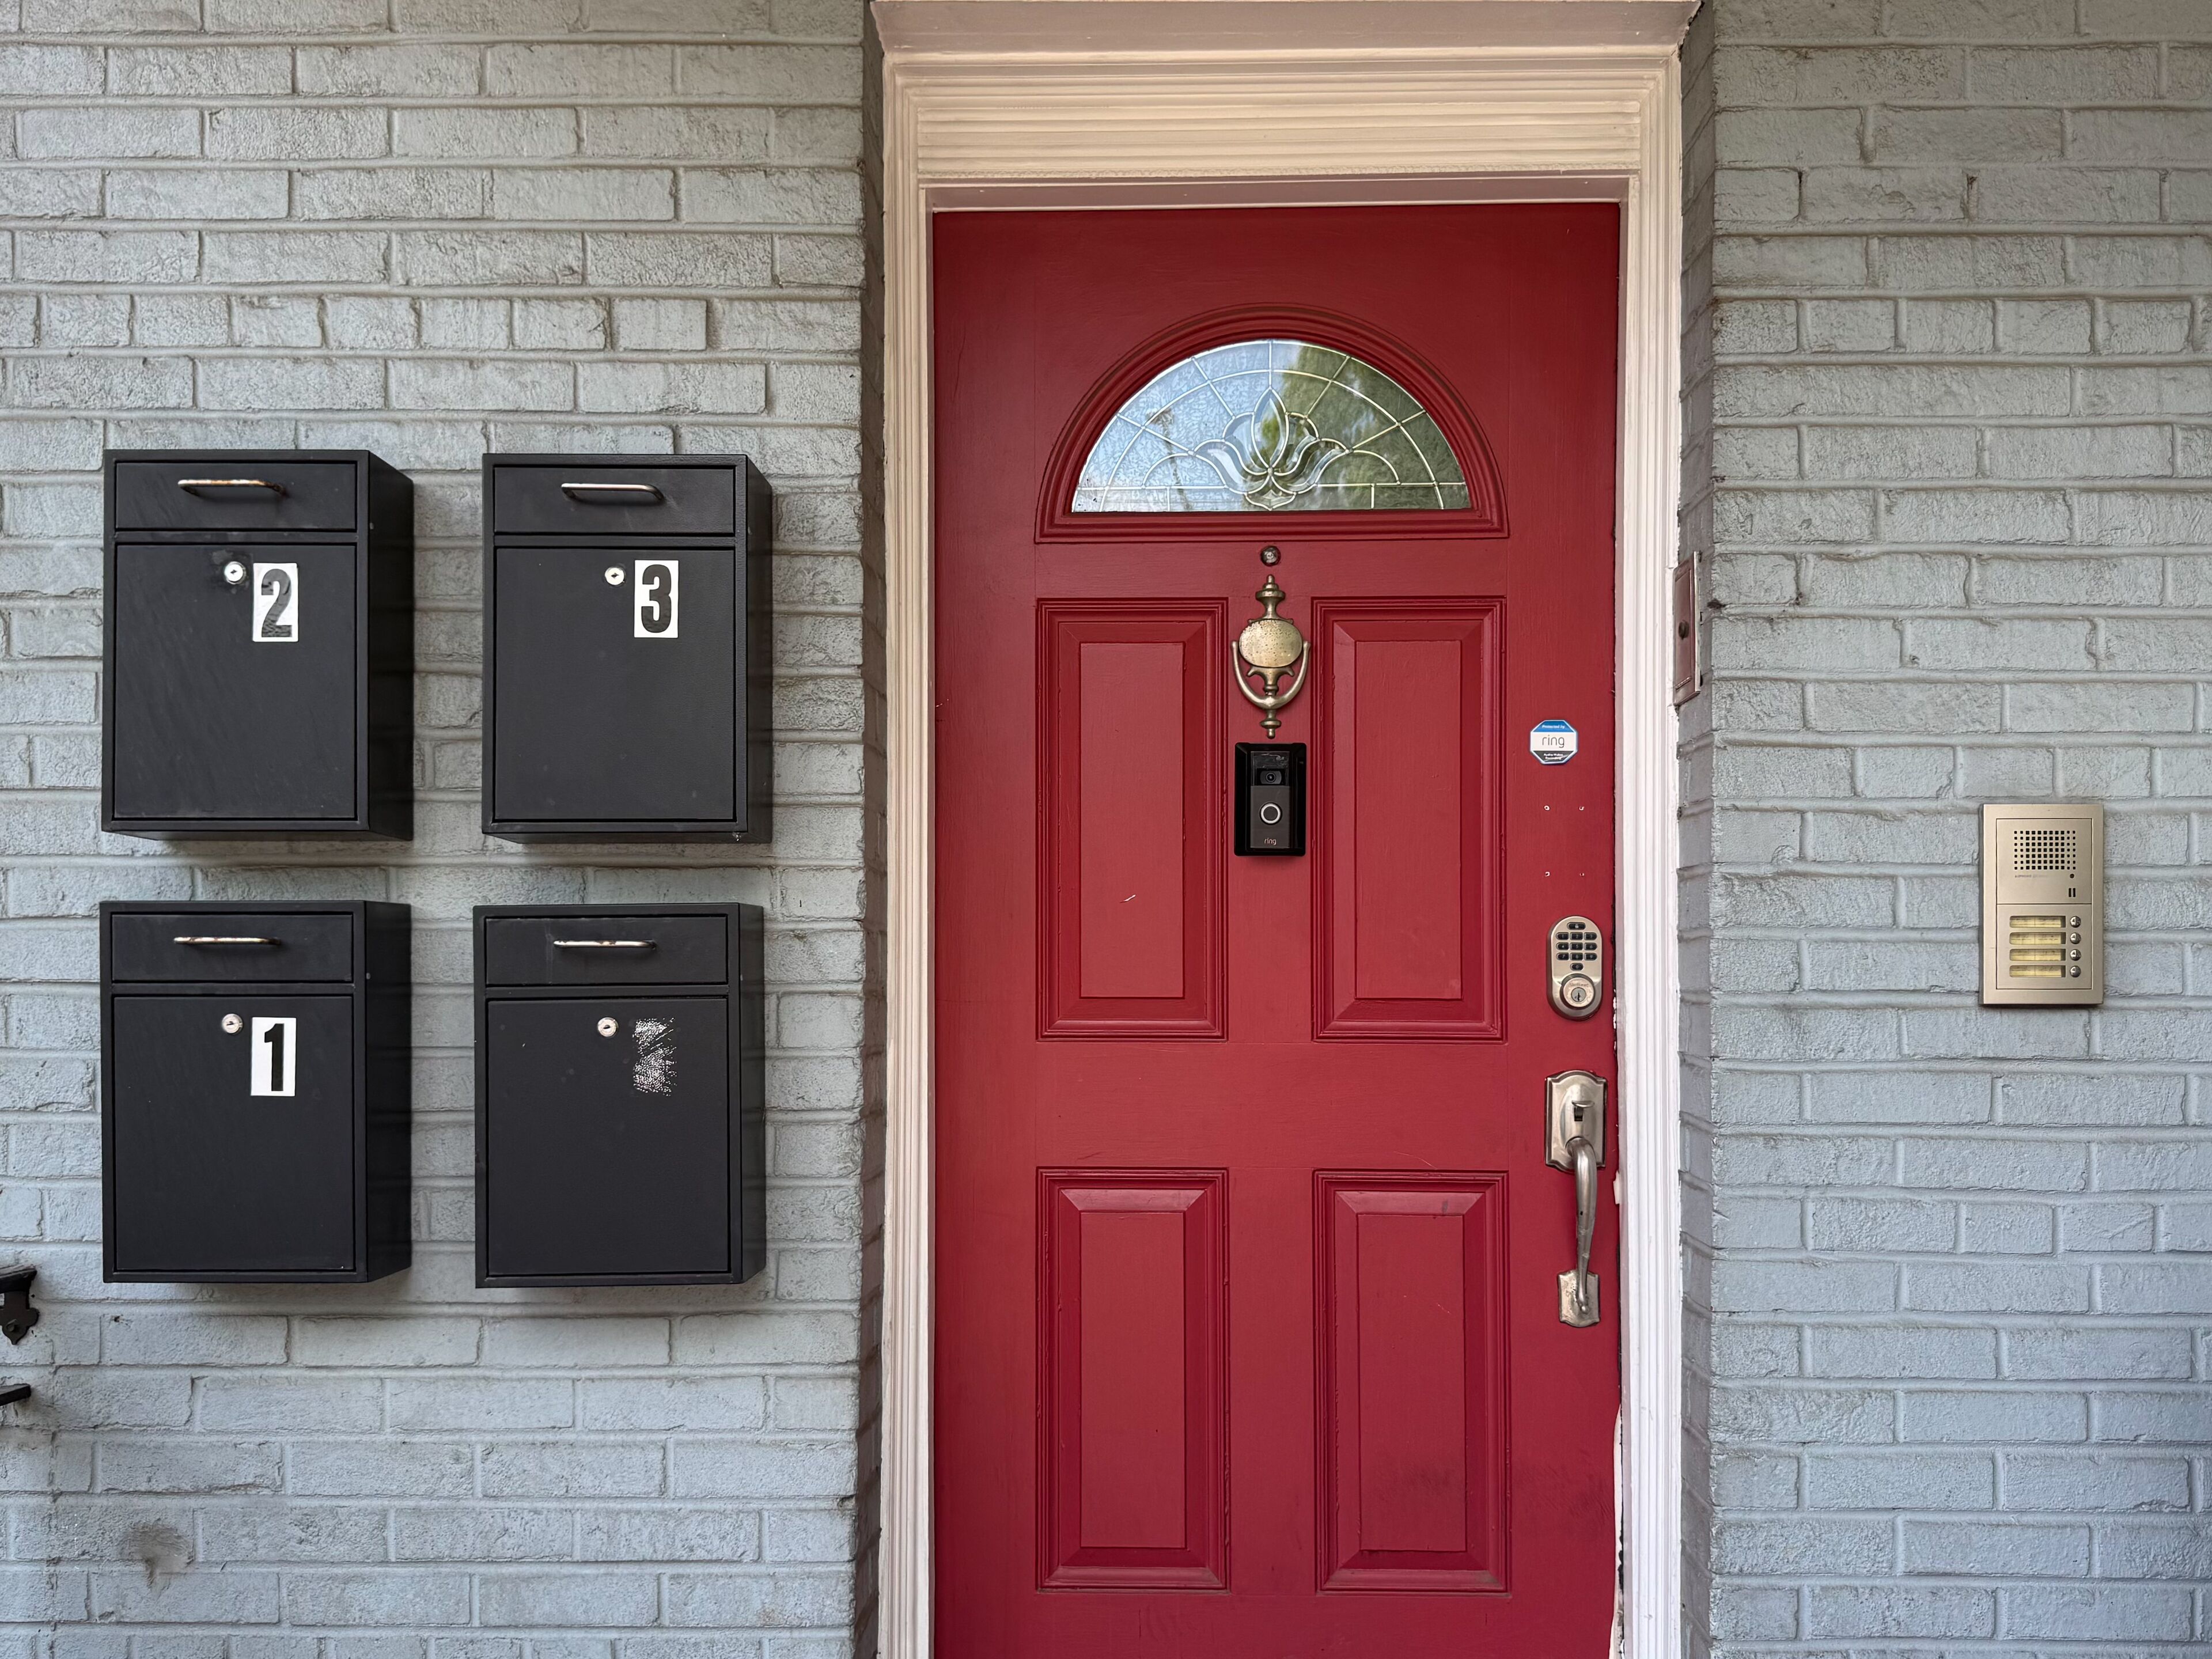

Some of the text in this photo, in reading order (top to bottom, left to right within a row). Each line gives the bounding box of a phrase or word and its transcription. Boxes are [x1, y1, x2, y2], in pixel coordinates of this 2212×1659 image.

[262, 569, 292, 637] 2
[641, 564, 672, 633] 3
[1542, 734, 1565, 748] ring
[1264, 837, 1277, 846] ring
[264, 1023, 285, 1091] 1
